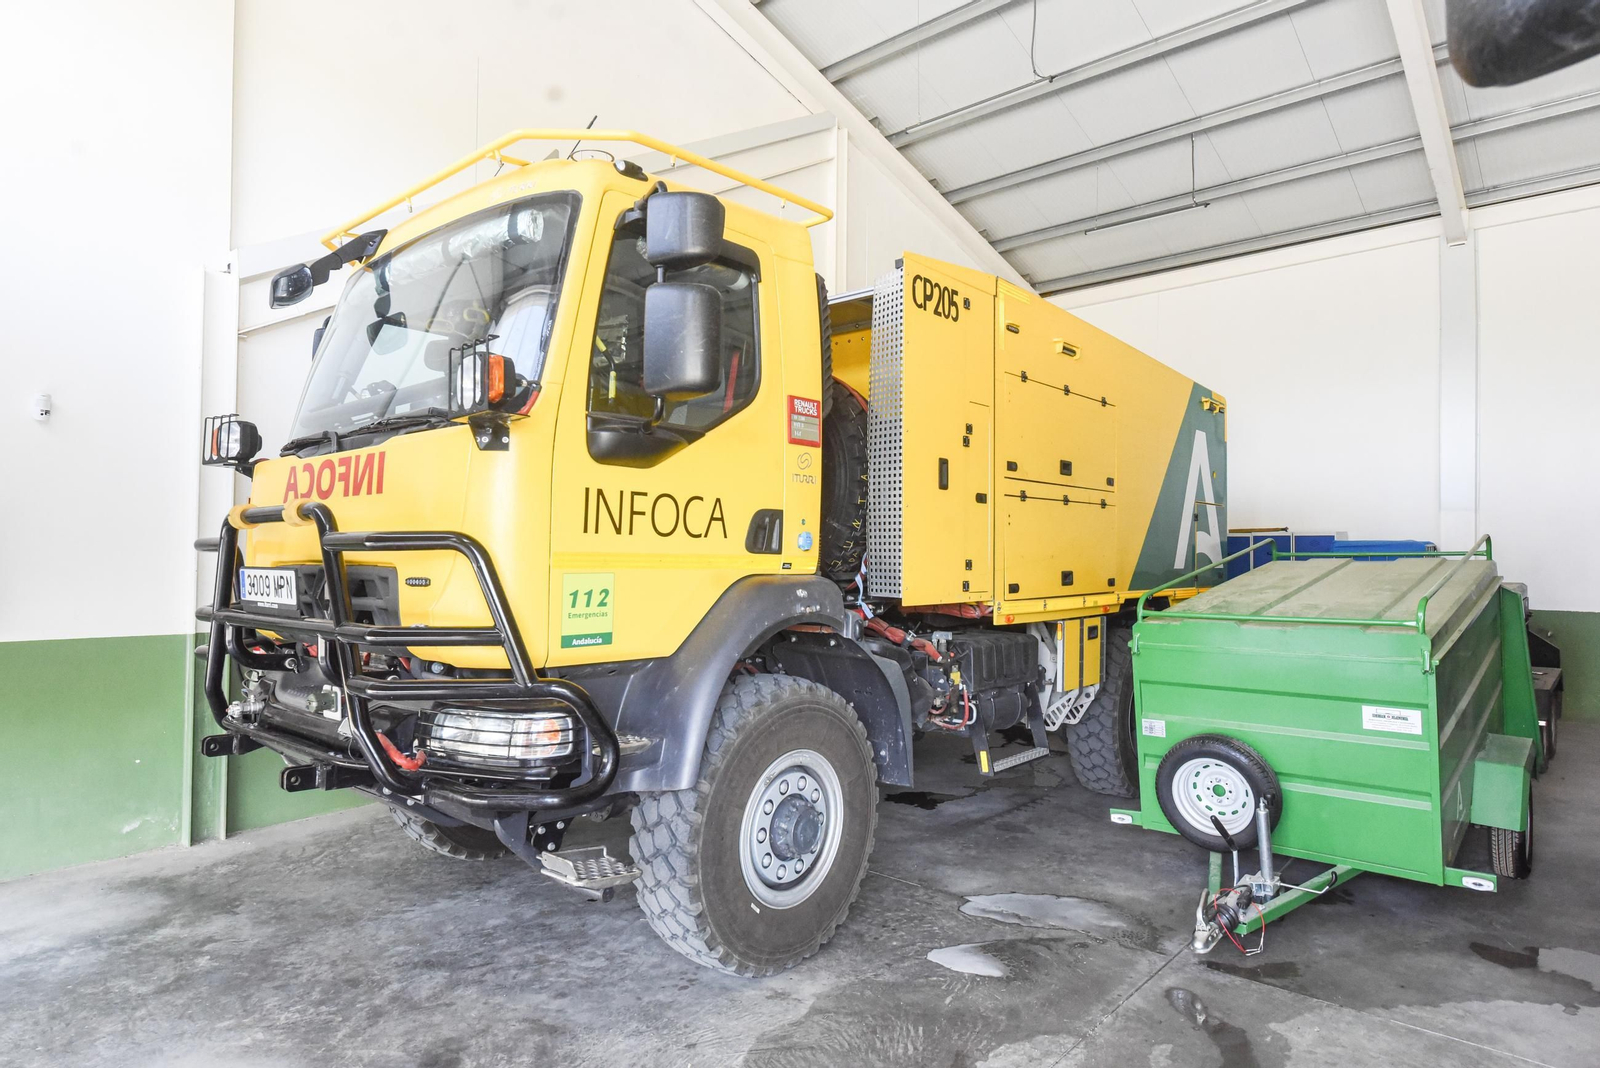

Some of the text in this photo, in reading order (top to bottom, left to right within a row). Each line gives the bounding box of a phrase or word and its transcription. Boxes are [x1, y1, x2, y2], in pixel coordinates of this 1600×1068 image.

[912, 274, 959, 322] CP205
[793, 398, 818, 409] RENAULT
[794, 405, 818, 416] TRUCKS
[792, 473, 817, 485] ITURRI
[583, 487, 728, 539] INFOCA
[247, 574, 271, 597] 3009
[569, 588, 610, 609] 112
[568, 611, 608, 620] Emergencias
[571, 636, 603, 646] Andalucía
